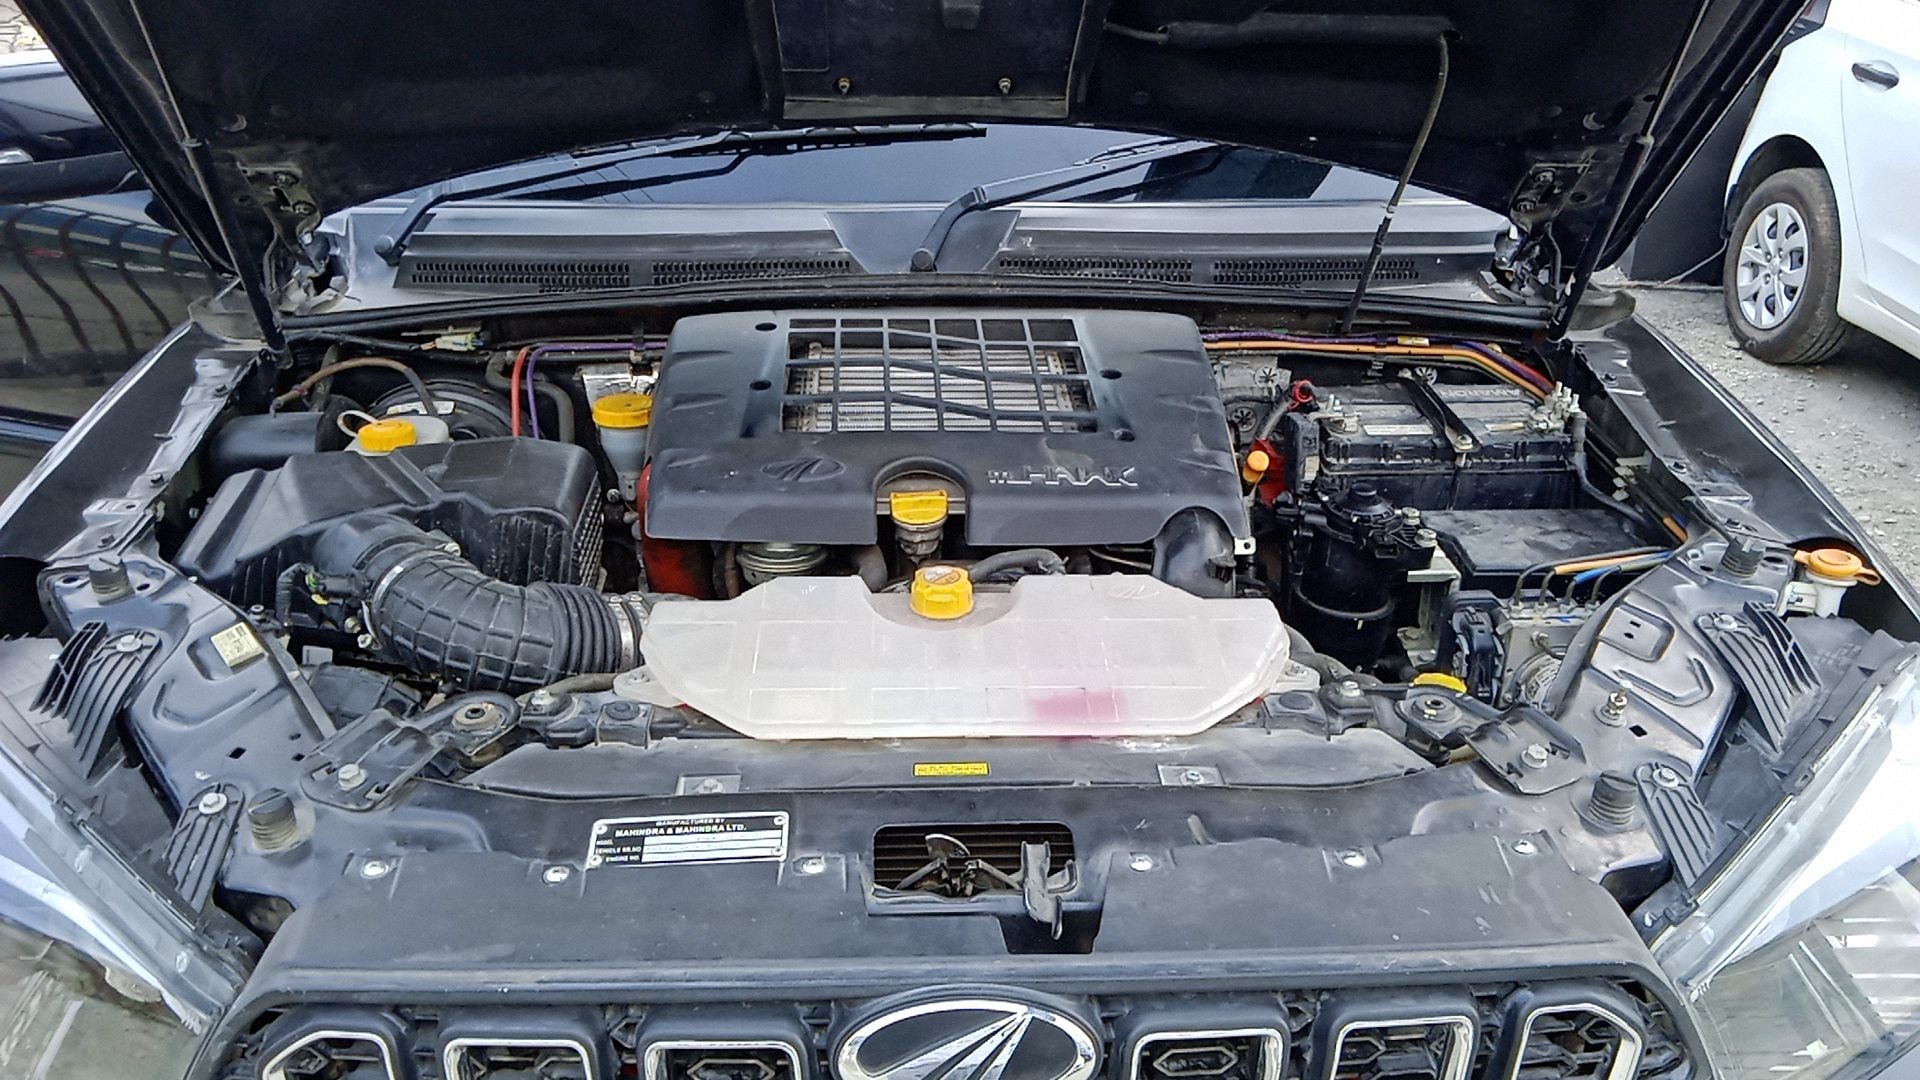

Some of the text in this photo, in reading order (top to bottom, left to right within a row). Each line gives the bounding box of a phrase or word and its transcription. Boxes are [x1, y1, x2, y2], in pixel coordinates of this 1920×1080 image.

[615, 827, 665, 837] MAHINDRA
[675, 824, 724, 834] MAHINDRA
[726, 823, 747, 831] LTD.
